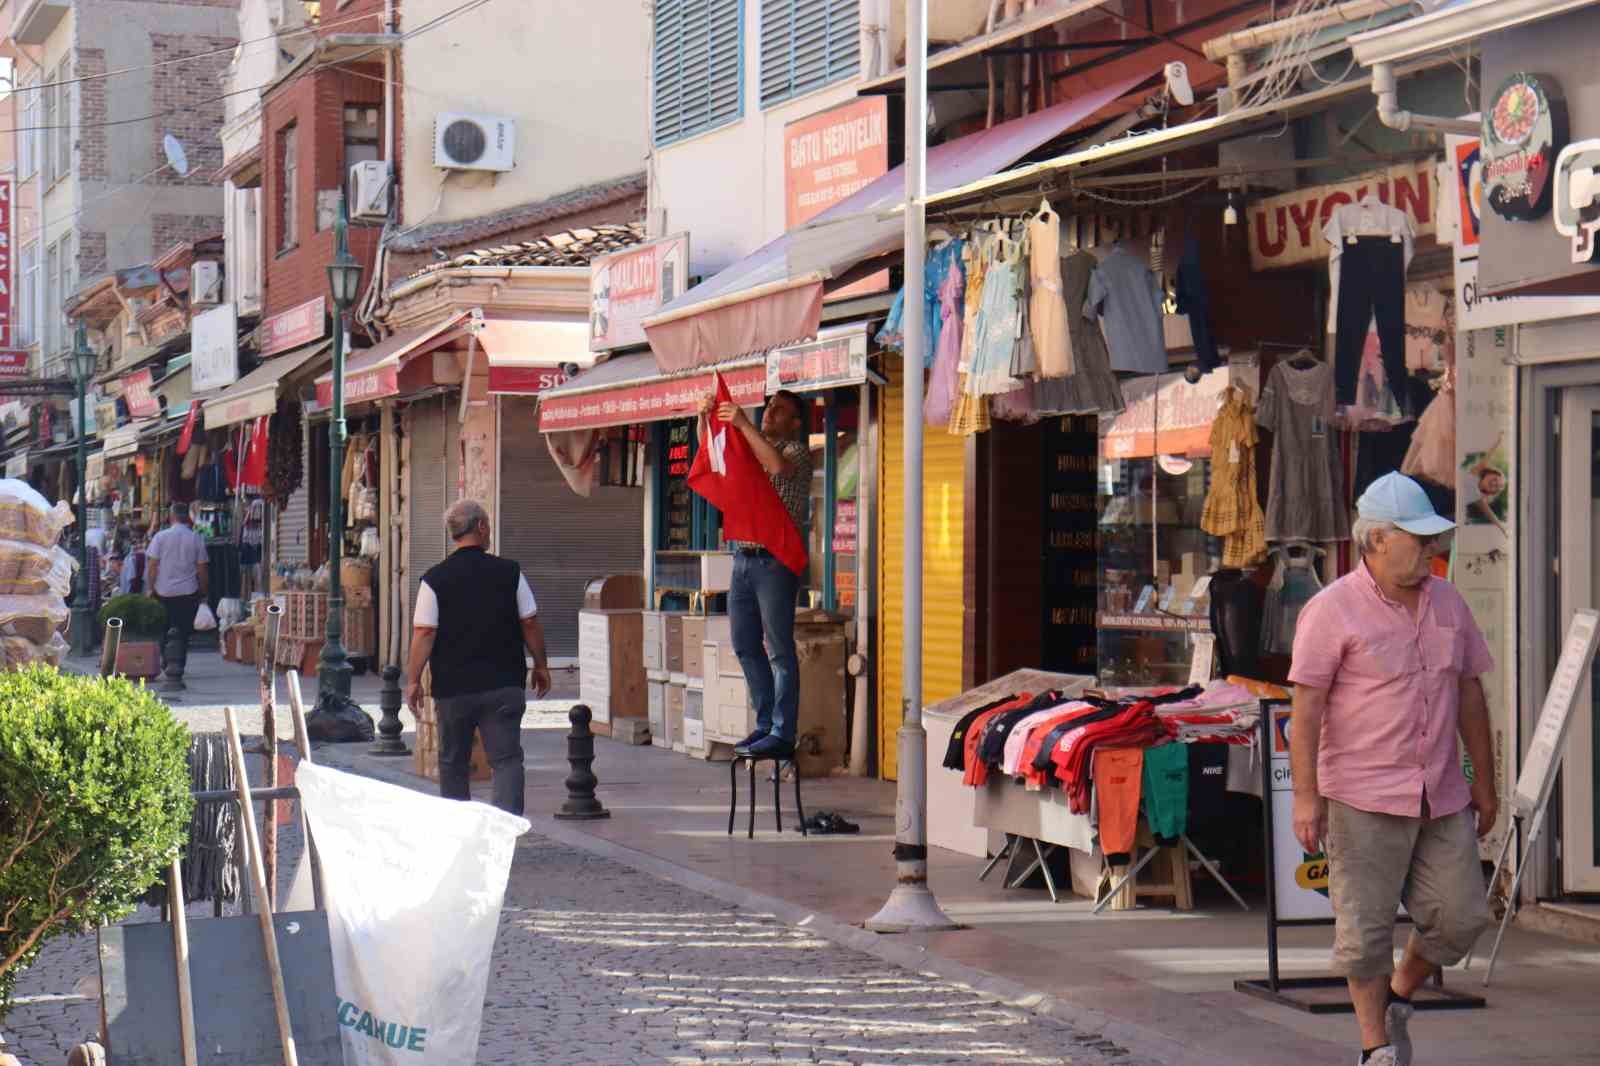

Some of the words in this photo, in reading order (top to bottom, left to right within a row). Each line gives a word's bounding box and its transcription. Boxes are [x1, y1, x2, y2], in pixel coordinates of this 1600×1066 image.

[791, 131, 820, 169] BATU
[1255, 171, 1431, 257] UYN
[1202, 766, 1224, 775] NIKE
